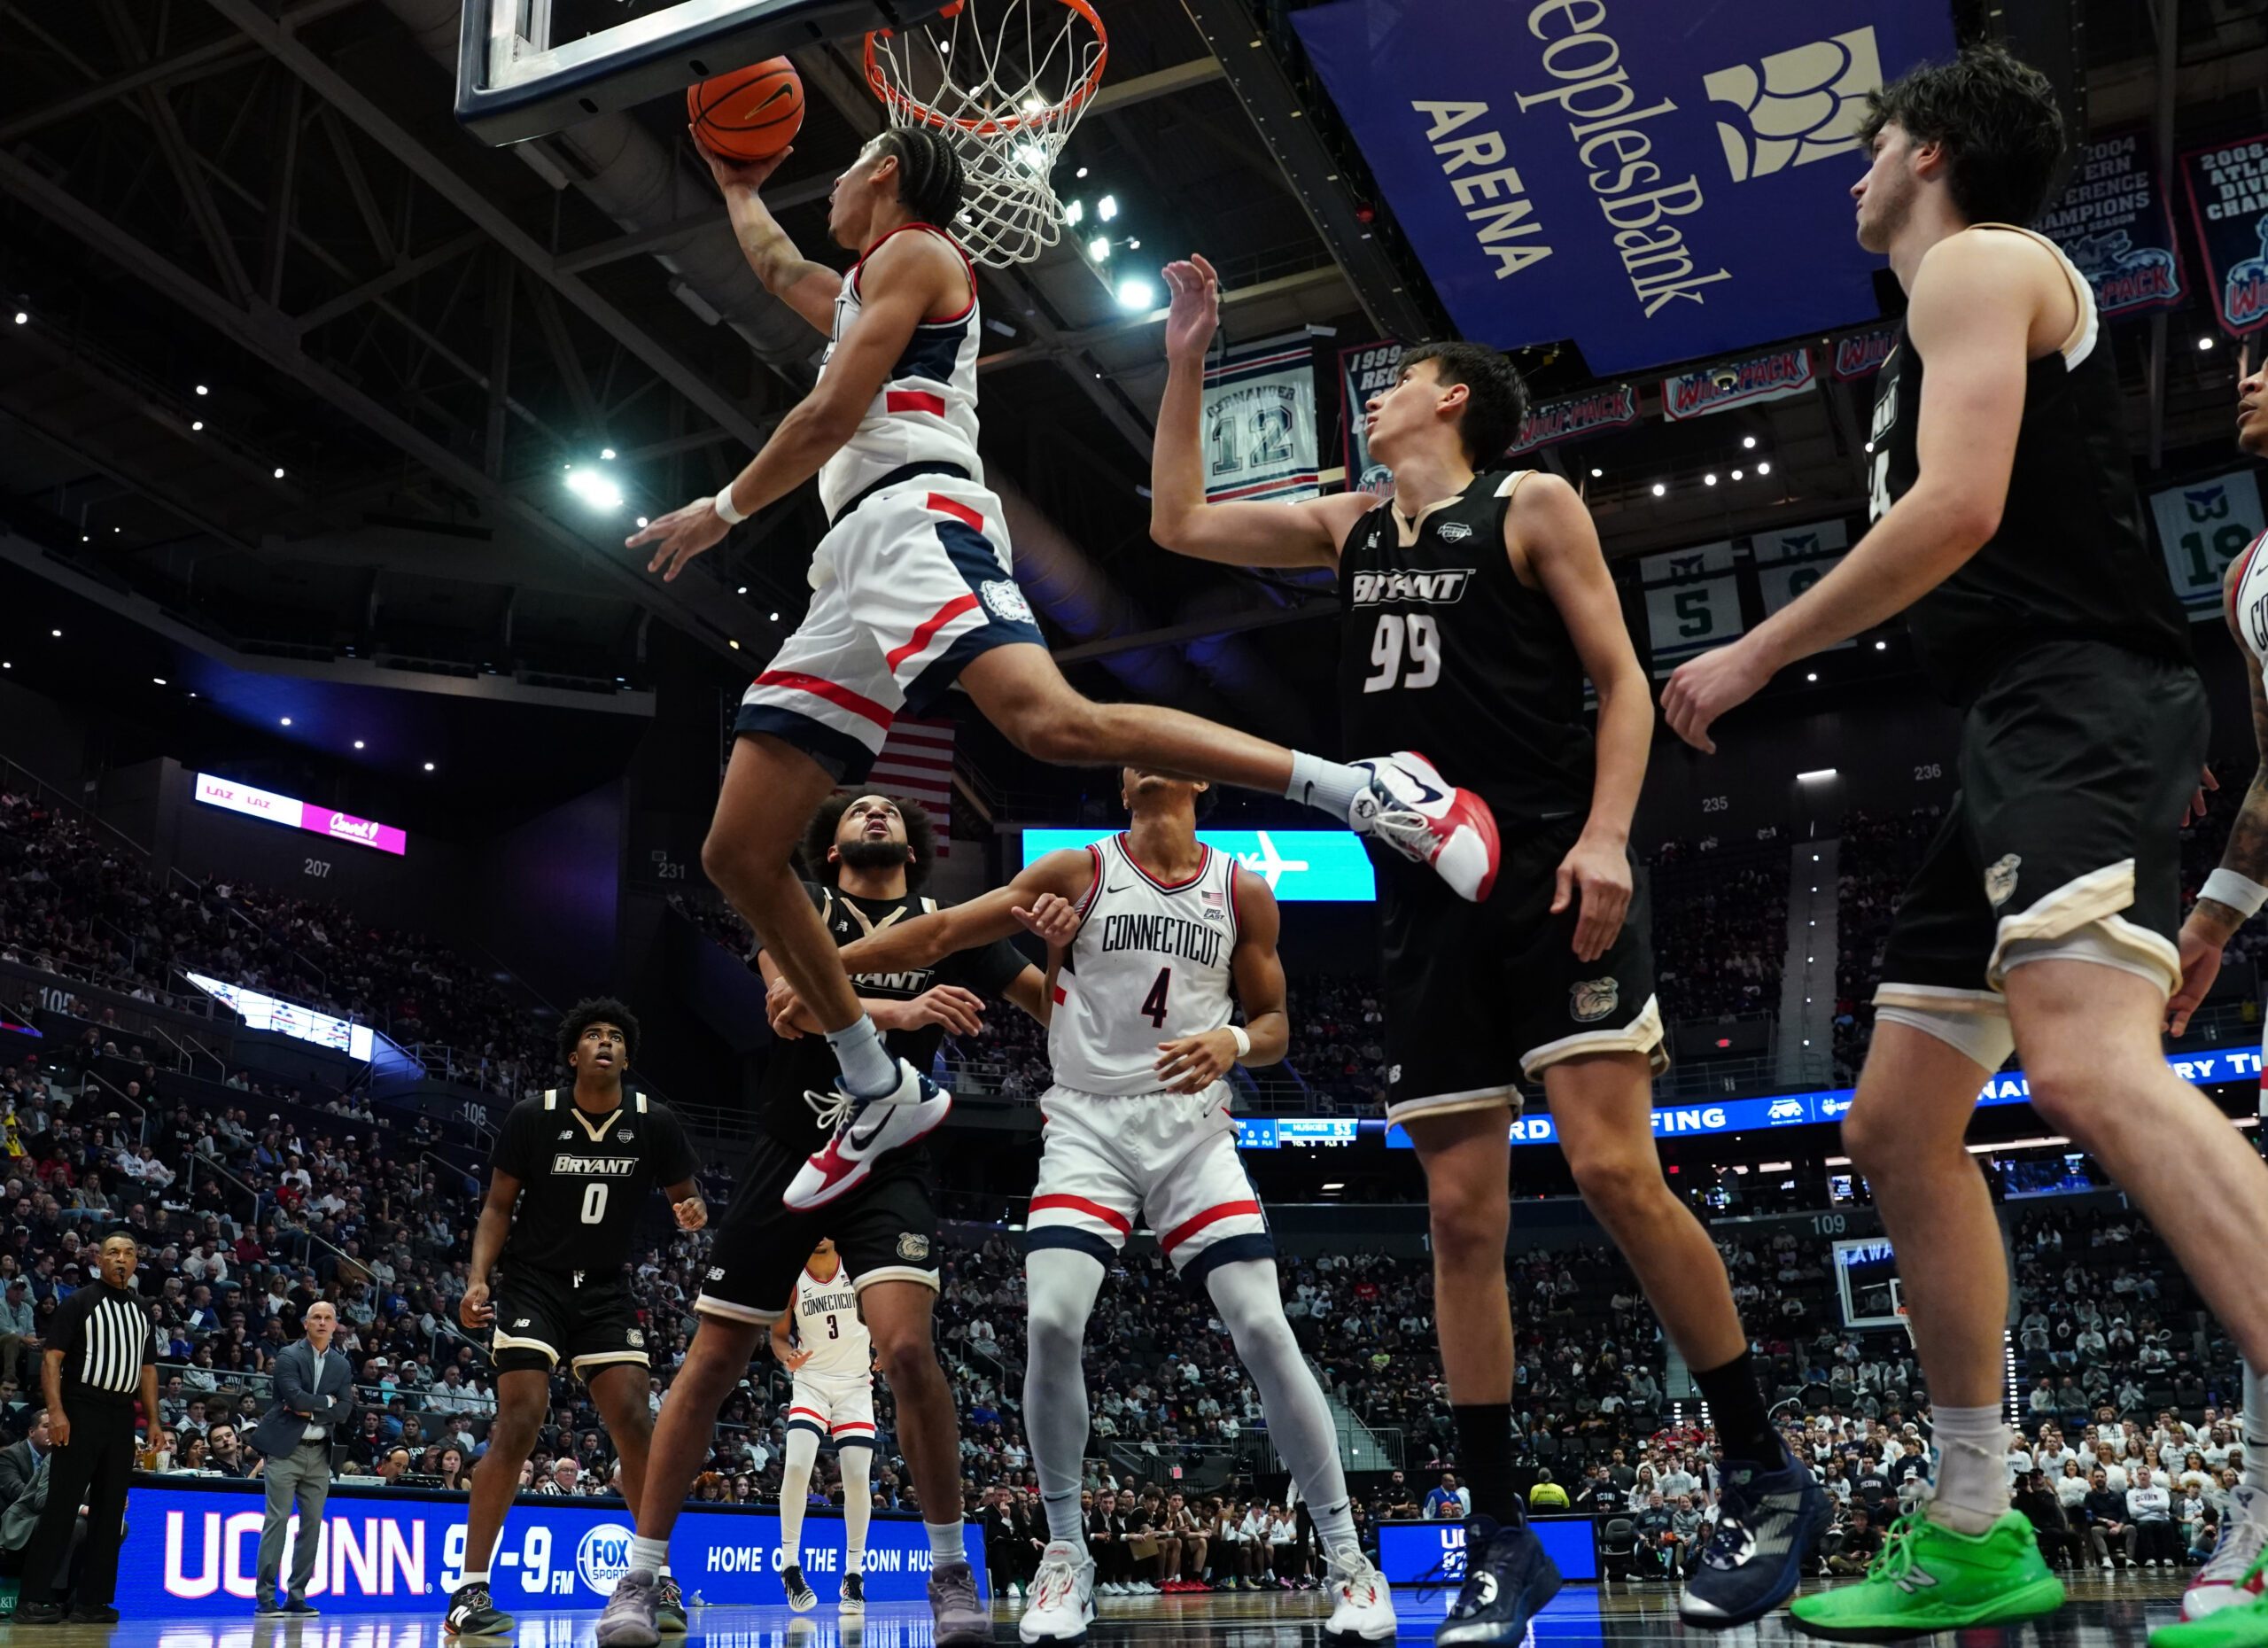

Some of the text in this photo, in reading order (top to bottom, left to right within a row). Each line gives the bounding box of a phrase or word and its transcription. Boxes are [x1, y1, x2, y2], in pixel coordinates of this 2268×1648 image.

[1411, 100, 1553, 280] ARENA
[1212, 405, 1293, 476] 12
[2180, 524, 2256, 587] 19
[1353, 573, 1465, 603] BRYANT
[1674, 588, 1713, 639] 5
[1363, 613, 1441, 694] 99
[1914, 764, 1942, 781] 236
[1702, 797, 1728, 812] 235
[305, 858, 331, 878] 207
[658, 862, 686, 879] 231
[1102, 913, 1223, 969] CONNECTICUT
[1141, 967, 1171, 1029] 4
[462, 1101, 487, 1126] 106
[1293, 1123, 1329, 1132] HUSKIES
[554, 1155, 633, 1174] BRYANT
[580, 1183, 609, 1224] 0
[1810, 1214, 1846, 1235] 109
[802, 1293, 857, 1318] CONNECTICUT
[826, 1314, 840, 1340] 3
[592, 1539, 630, 1568] FOX
[706, 1546, 763, 1573] HOME
[804, 1548, 837, 1573] THE
[859, 1549, 901, 1573] CONN
[551, 1570, 575, 1595] FM
